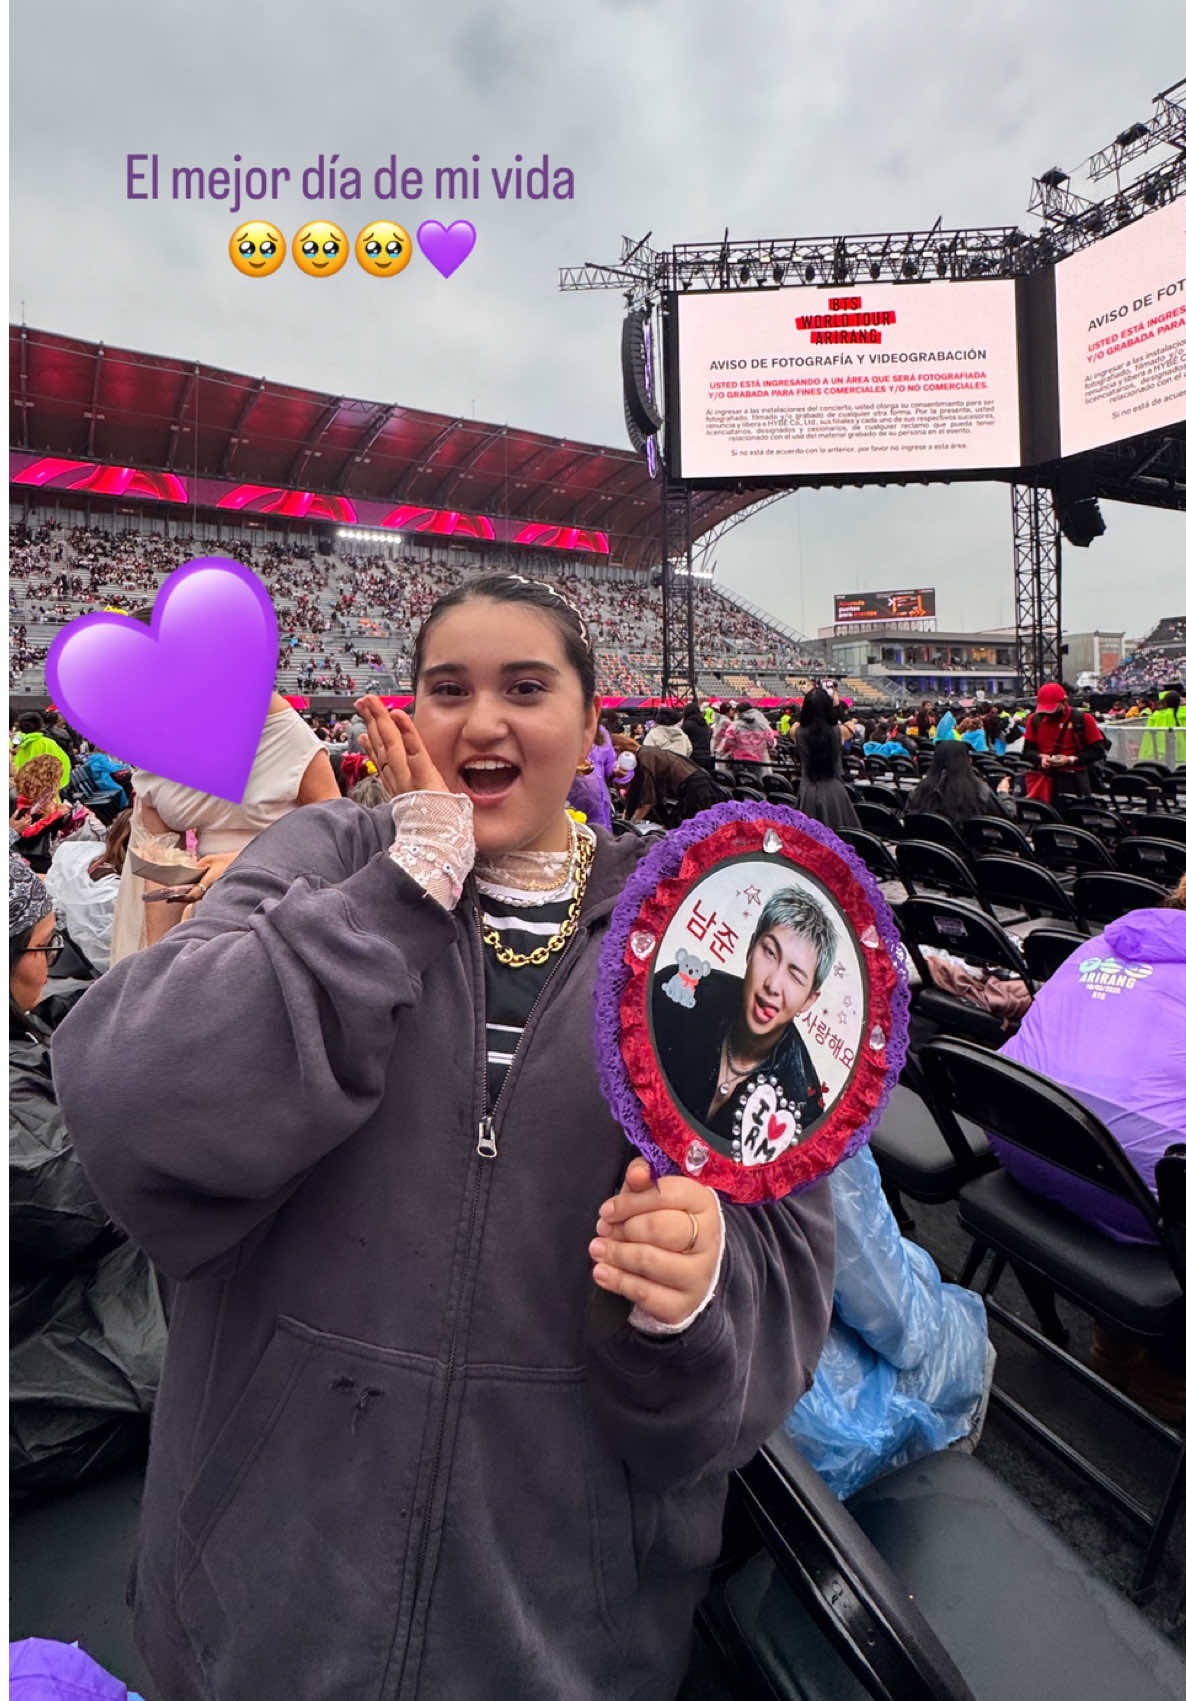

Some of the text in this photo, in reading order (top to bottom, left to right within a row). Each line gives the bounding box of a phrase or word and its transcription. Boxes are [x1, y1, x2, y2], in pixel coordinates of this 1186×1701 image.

[832, 297, 859, 311] BTS
[1088, 305, 1129, 332] AVISO
[1133, 293, 1153, 312] DE
[801, 311, 891, 329] WORLD TOUR
[815, 329, 878, 345] ARIRANG
[1087, 318, 1186, 363] Y/O GRABADA PARA
[1088, 333, 1119, 352] USTED
[1121, 320, 1145, 338] ESTÁ
[710, 347, 987, 371] AVISO DE FOTOGRAFÍA Y VIDEOGRABACIÓN
[709, 381, 737, 389] USTED
[740, 379, 761, 388] ESTÁ
[763, 378, 820, 387] INGRESANDO
[831, 377, 844, 385] UN
[845, 374, 869, 384] ÁREA
[871, 375, 890, 383] QUE
[892, 373, 916, 382] SERÁ
[917, 371, 987, 381] FOTOGRAFIADA
[709, 381, 987, 400] Y/O GRABADA PARA FINES COMERCIALES Y/O NO COMERCIALES.
[686, 900, 740, 964] 남준
[1080, 972, 1136, 990] ARIRANG
[801, 1009, 856, 1070] 사랑해요
[752, 1098, 770, 1126] I
[744, 1125, 776, 1162] RM
